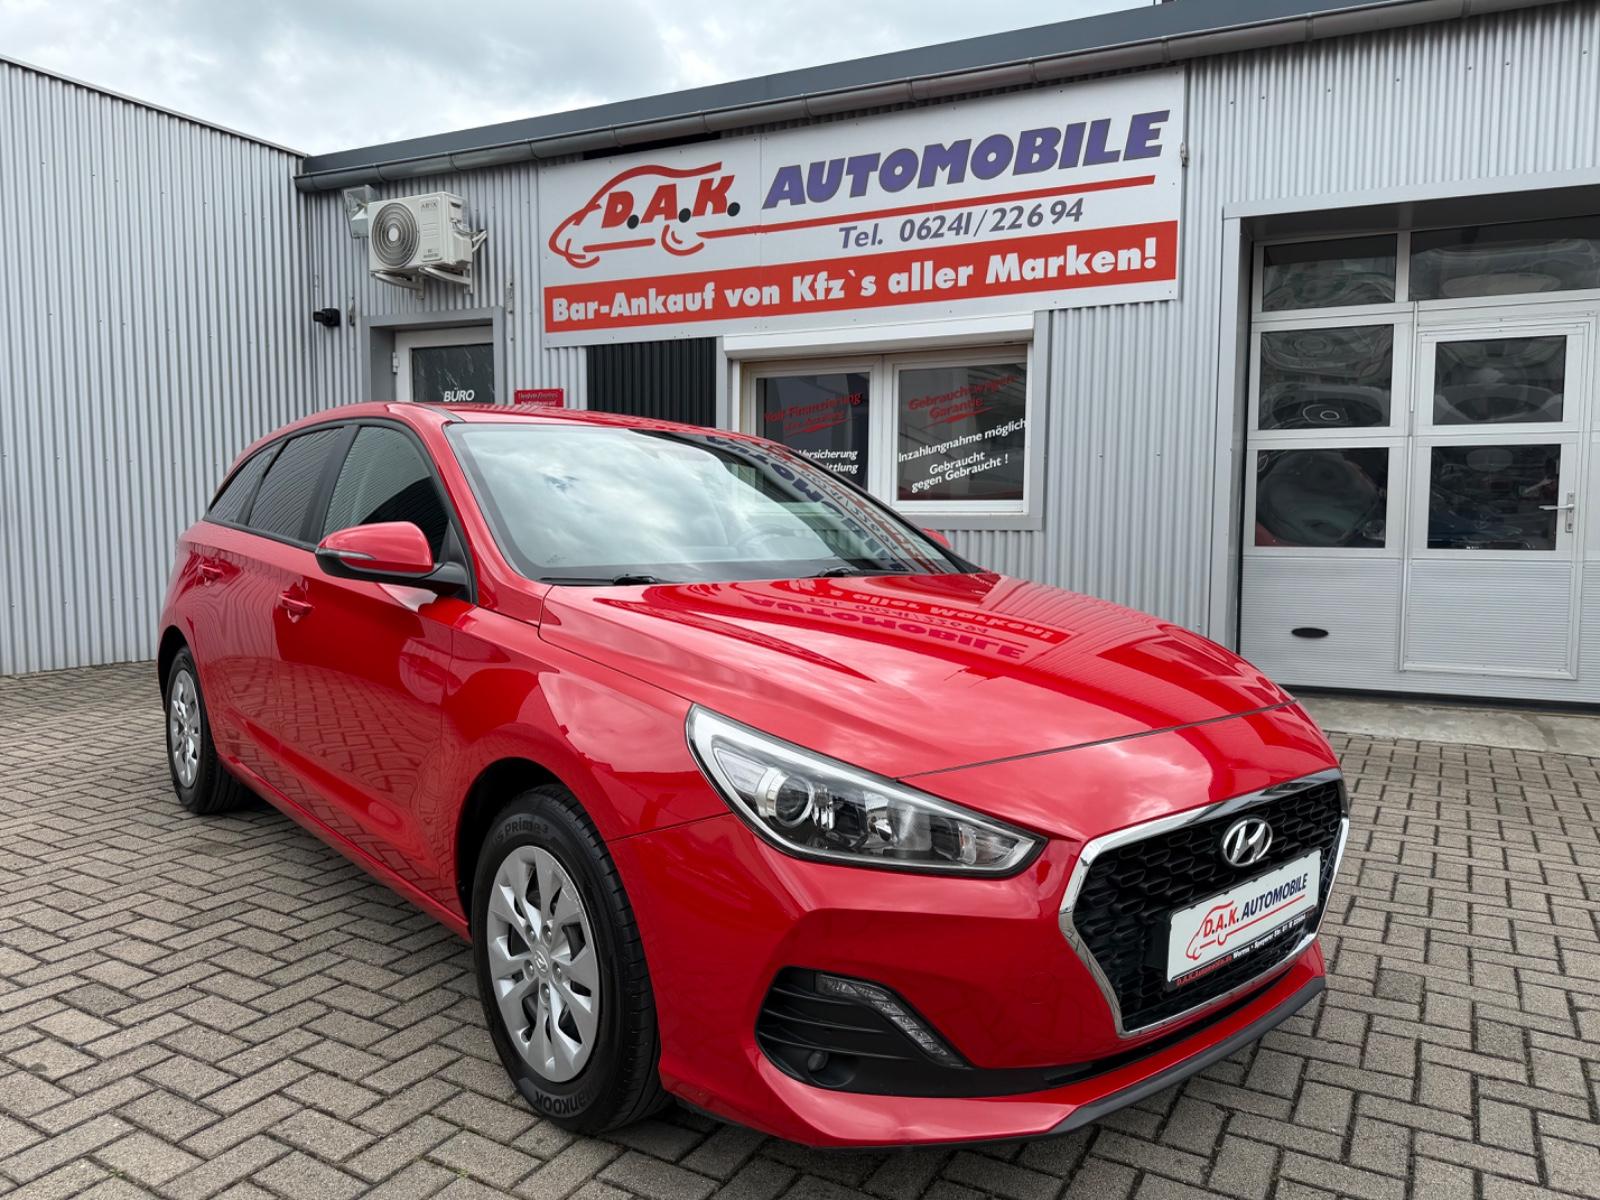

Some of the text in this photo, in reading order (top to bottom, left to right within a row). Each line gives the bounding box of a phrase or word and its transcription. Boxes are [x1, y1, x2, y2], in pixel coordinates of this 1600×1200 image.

[601, 109, 1170, 230] D.A.K. AUTOMOBILE
[839, 223, 884, 249] Tel.
[552, 282, 715, 323] Bar-Ankauf
[724, 284, 781, 308] von
[888, 260, 974, 294] aller
[985, 236, 1157, 285] Marken!
[443, 387, 475, 402] BÜRO
[929, 397, 983, 420] Garantie
[898, 418, 1026, 462] Inzahlungnahme möglich
[911, 475, 942, 493] gegen
[945, 457, 1002, 481] Gebraucht
[929, 451, 986, 475] Gebraucht
[1203, 906, 1240, 938] D.A.K.
[1240, 873, 1309, 921] AUTOMOBILE
